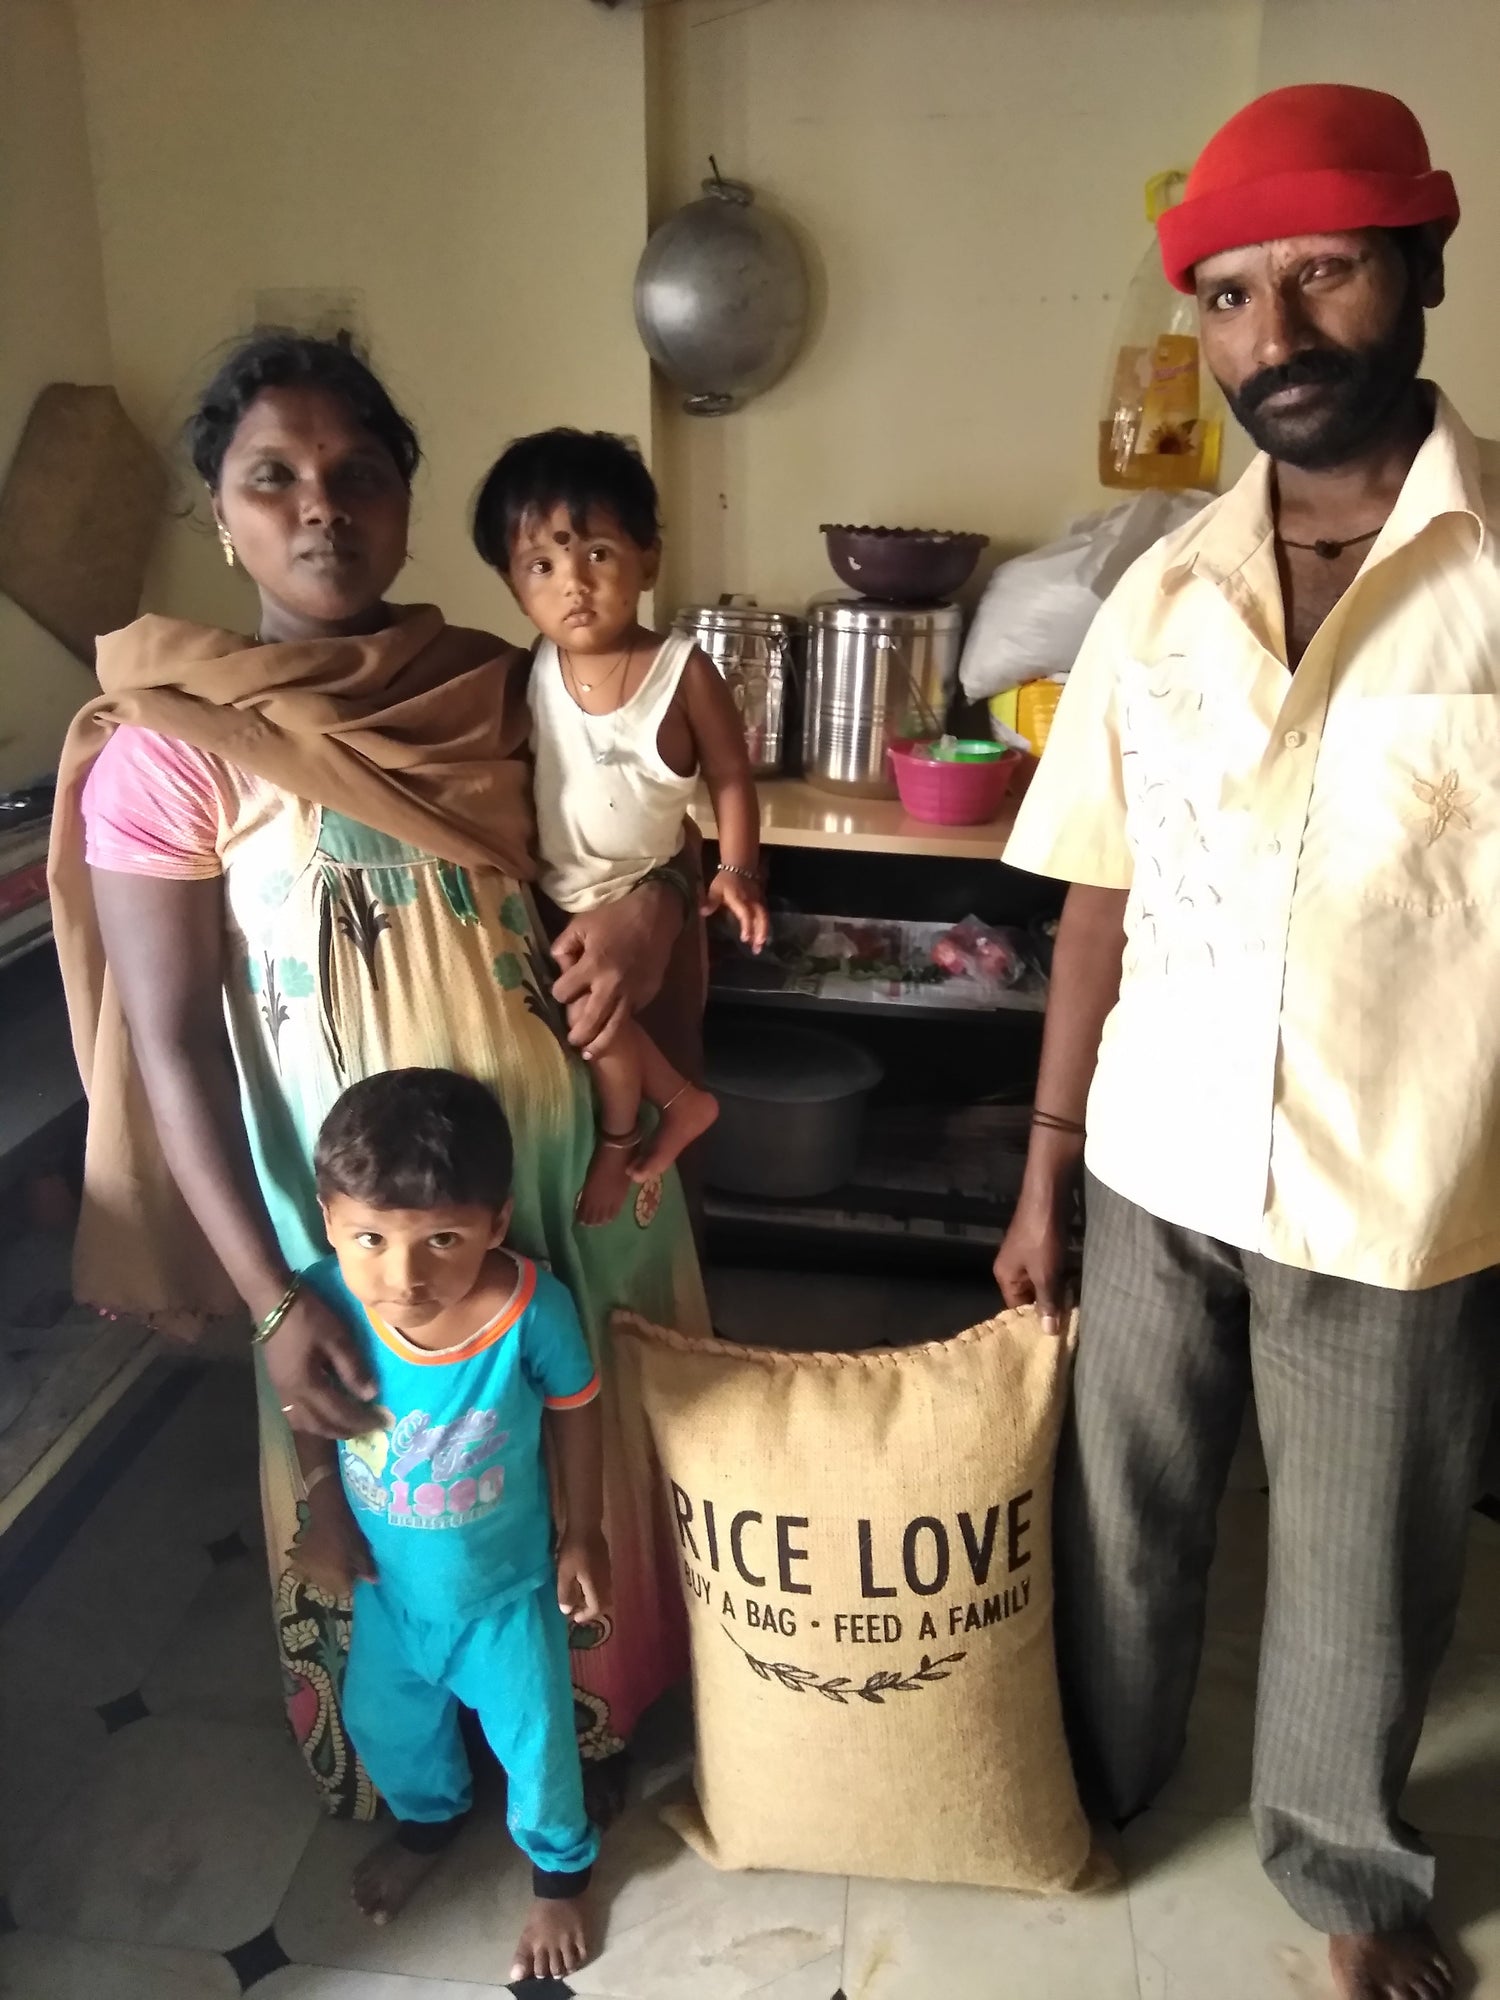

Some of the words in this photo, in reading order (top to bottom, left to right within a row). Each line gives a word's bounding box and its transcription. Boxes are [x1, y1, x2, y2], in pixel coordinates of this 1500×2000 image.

[670, 1479, 812, 1595] RICE
[858, 1489, 1033, 1598] LOVE
[684, 1559, 711, 1605] BUY
[722, 1590, 736, 1620] A
[746, 1599, 797, 1637] BAG
[834, 1614, 902, 1643] FEED
[918, 1611, 937, 1641] A
[949, 1577, 1030, 1636] FAMILY
